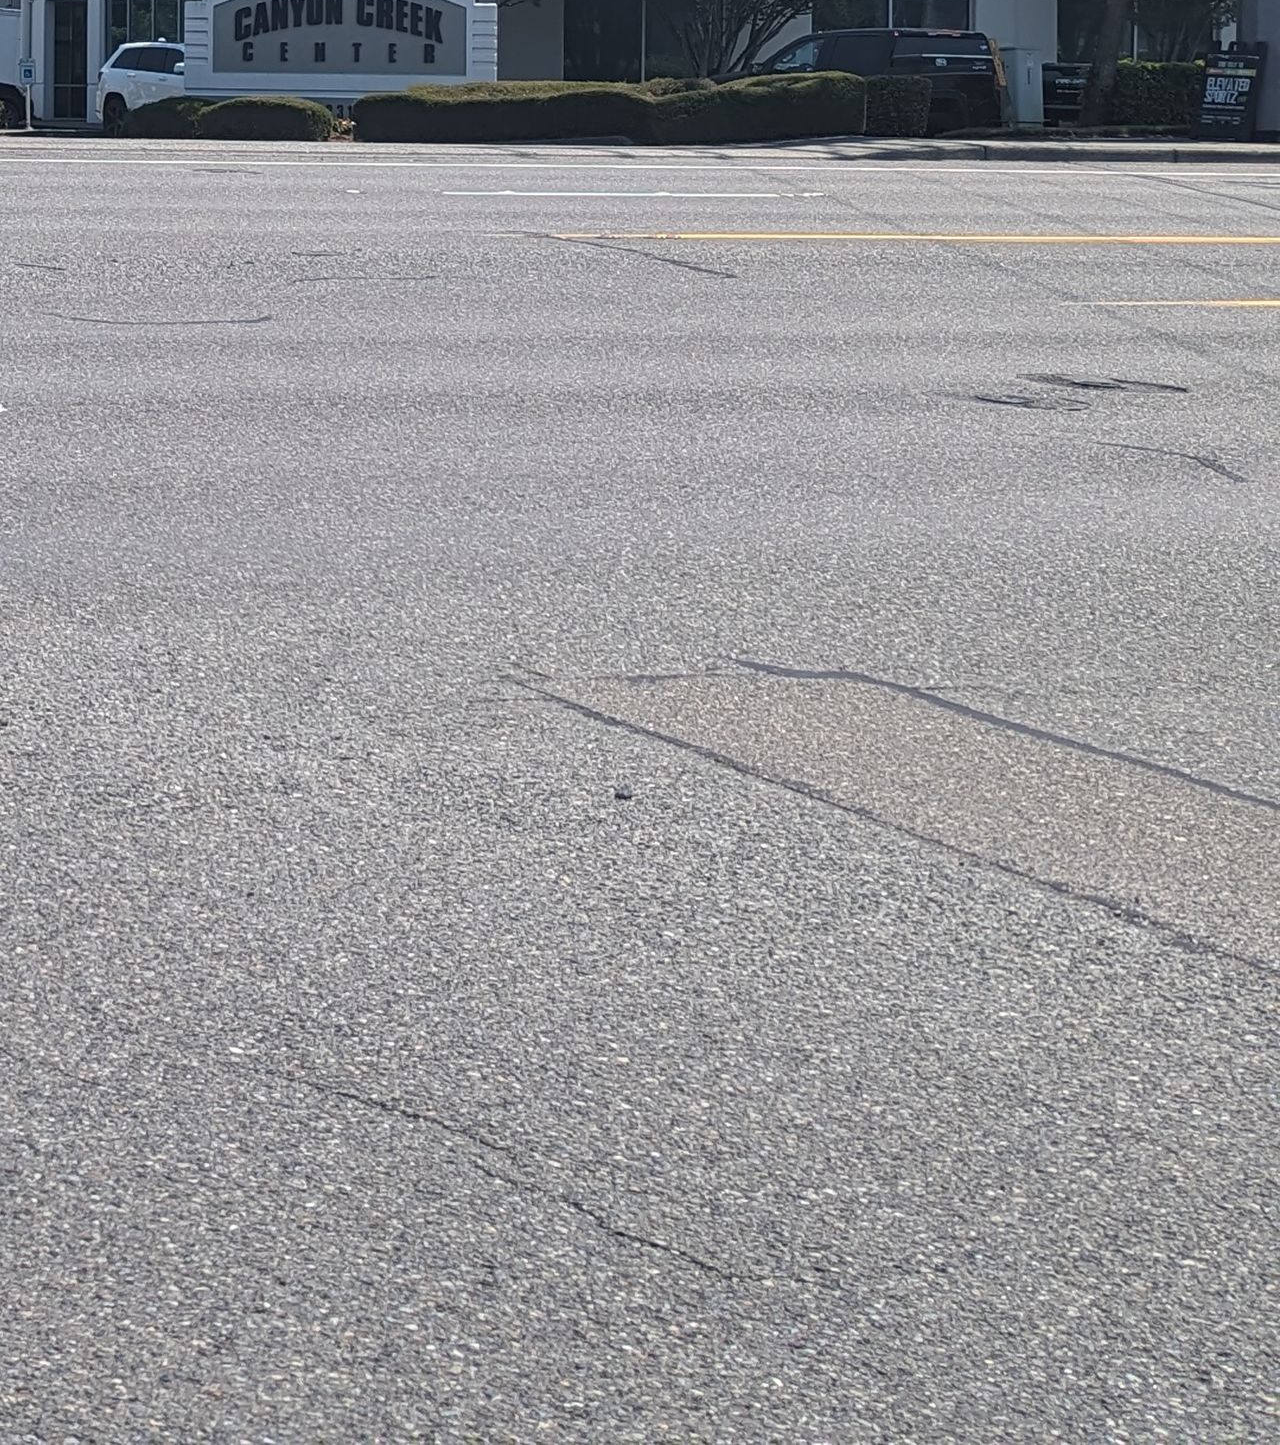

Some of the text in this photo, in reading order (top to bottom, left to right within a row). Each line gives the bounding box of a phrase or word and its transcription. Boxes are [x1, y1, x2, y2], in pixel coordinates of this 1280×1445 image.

[242, 42, 436, 64] CENTER
[1206, 77, 1251, 91] ELEVATED
[1203, 90, 1239, 103] SPORTZ
